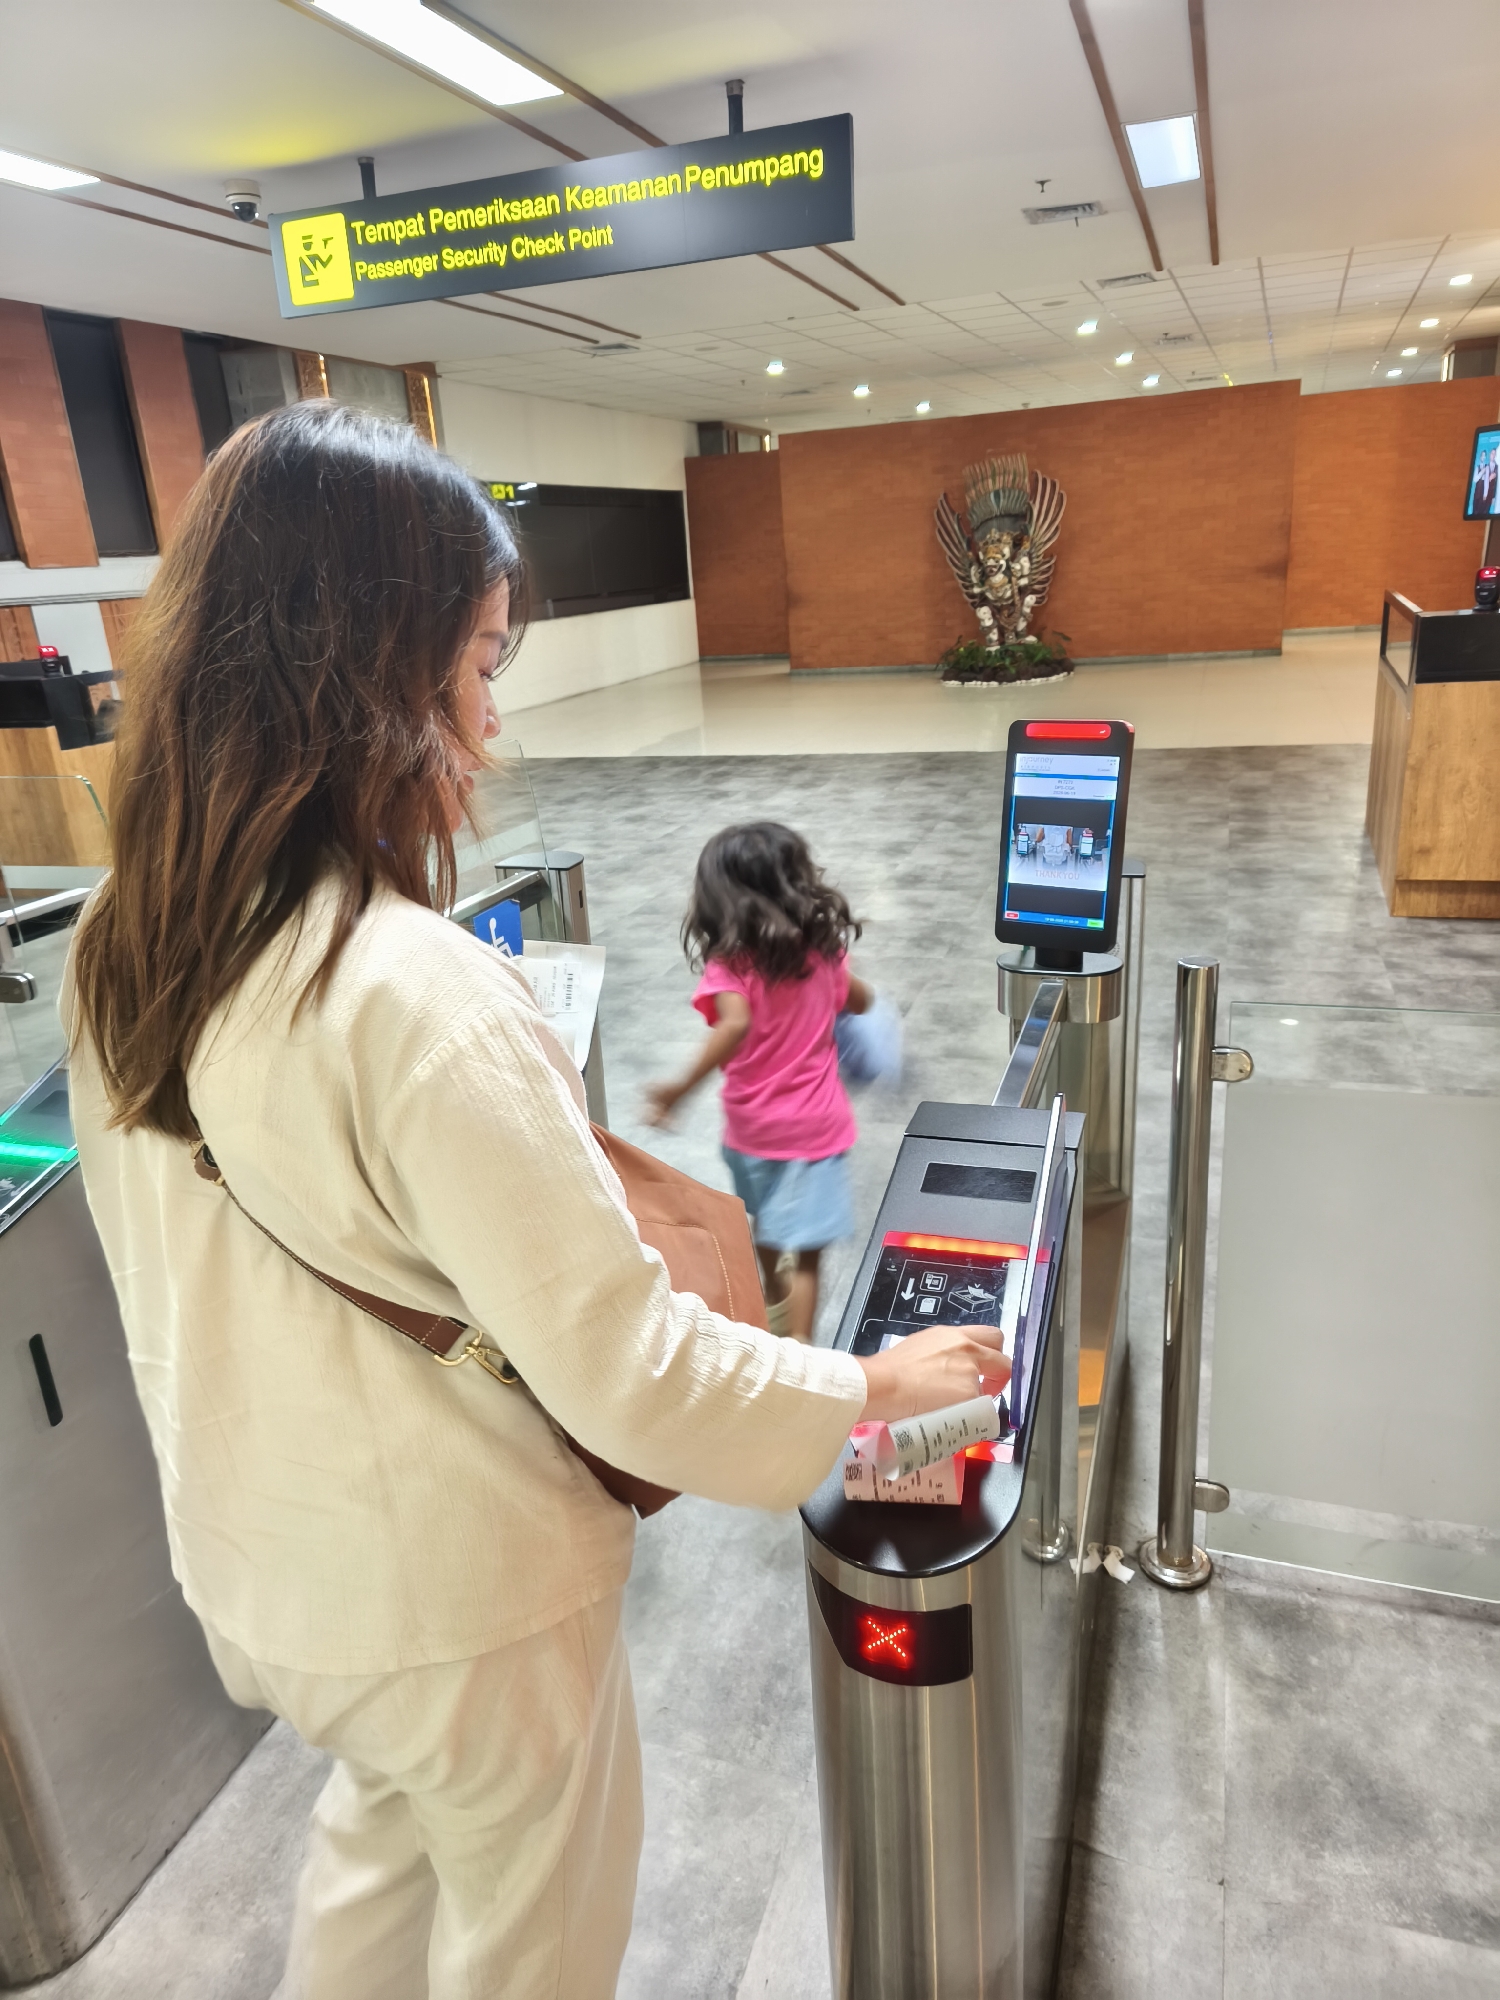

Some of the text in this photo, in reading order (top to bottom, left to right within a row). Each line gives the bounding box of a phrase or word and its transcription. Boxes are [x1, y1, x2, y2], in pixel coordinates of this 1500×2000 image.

[350, 148, 824, 245] Tempat Pemeriksaan Keamanan Penumpang
[355, 224, 614, 281] Passenger Security Check Point
[1035, 870, 1080, 881] THANK YOU
